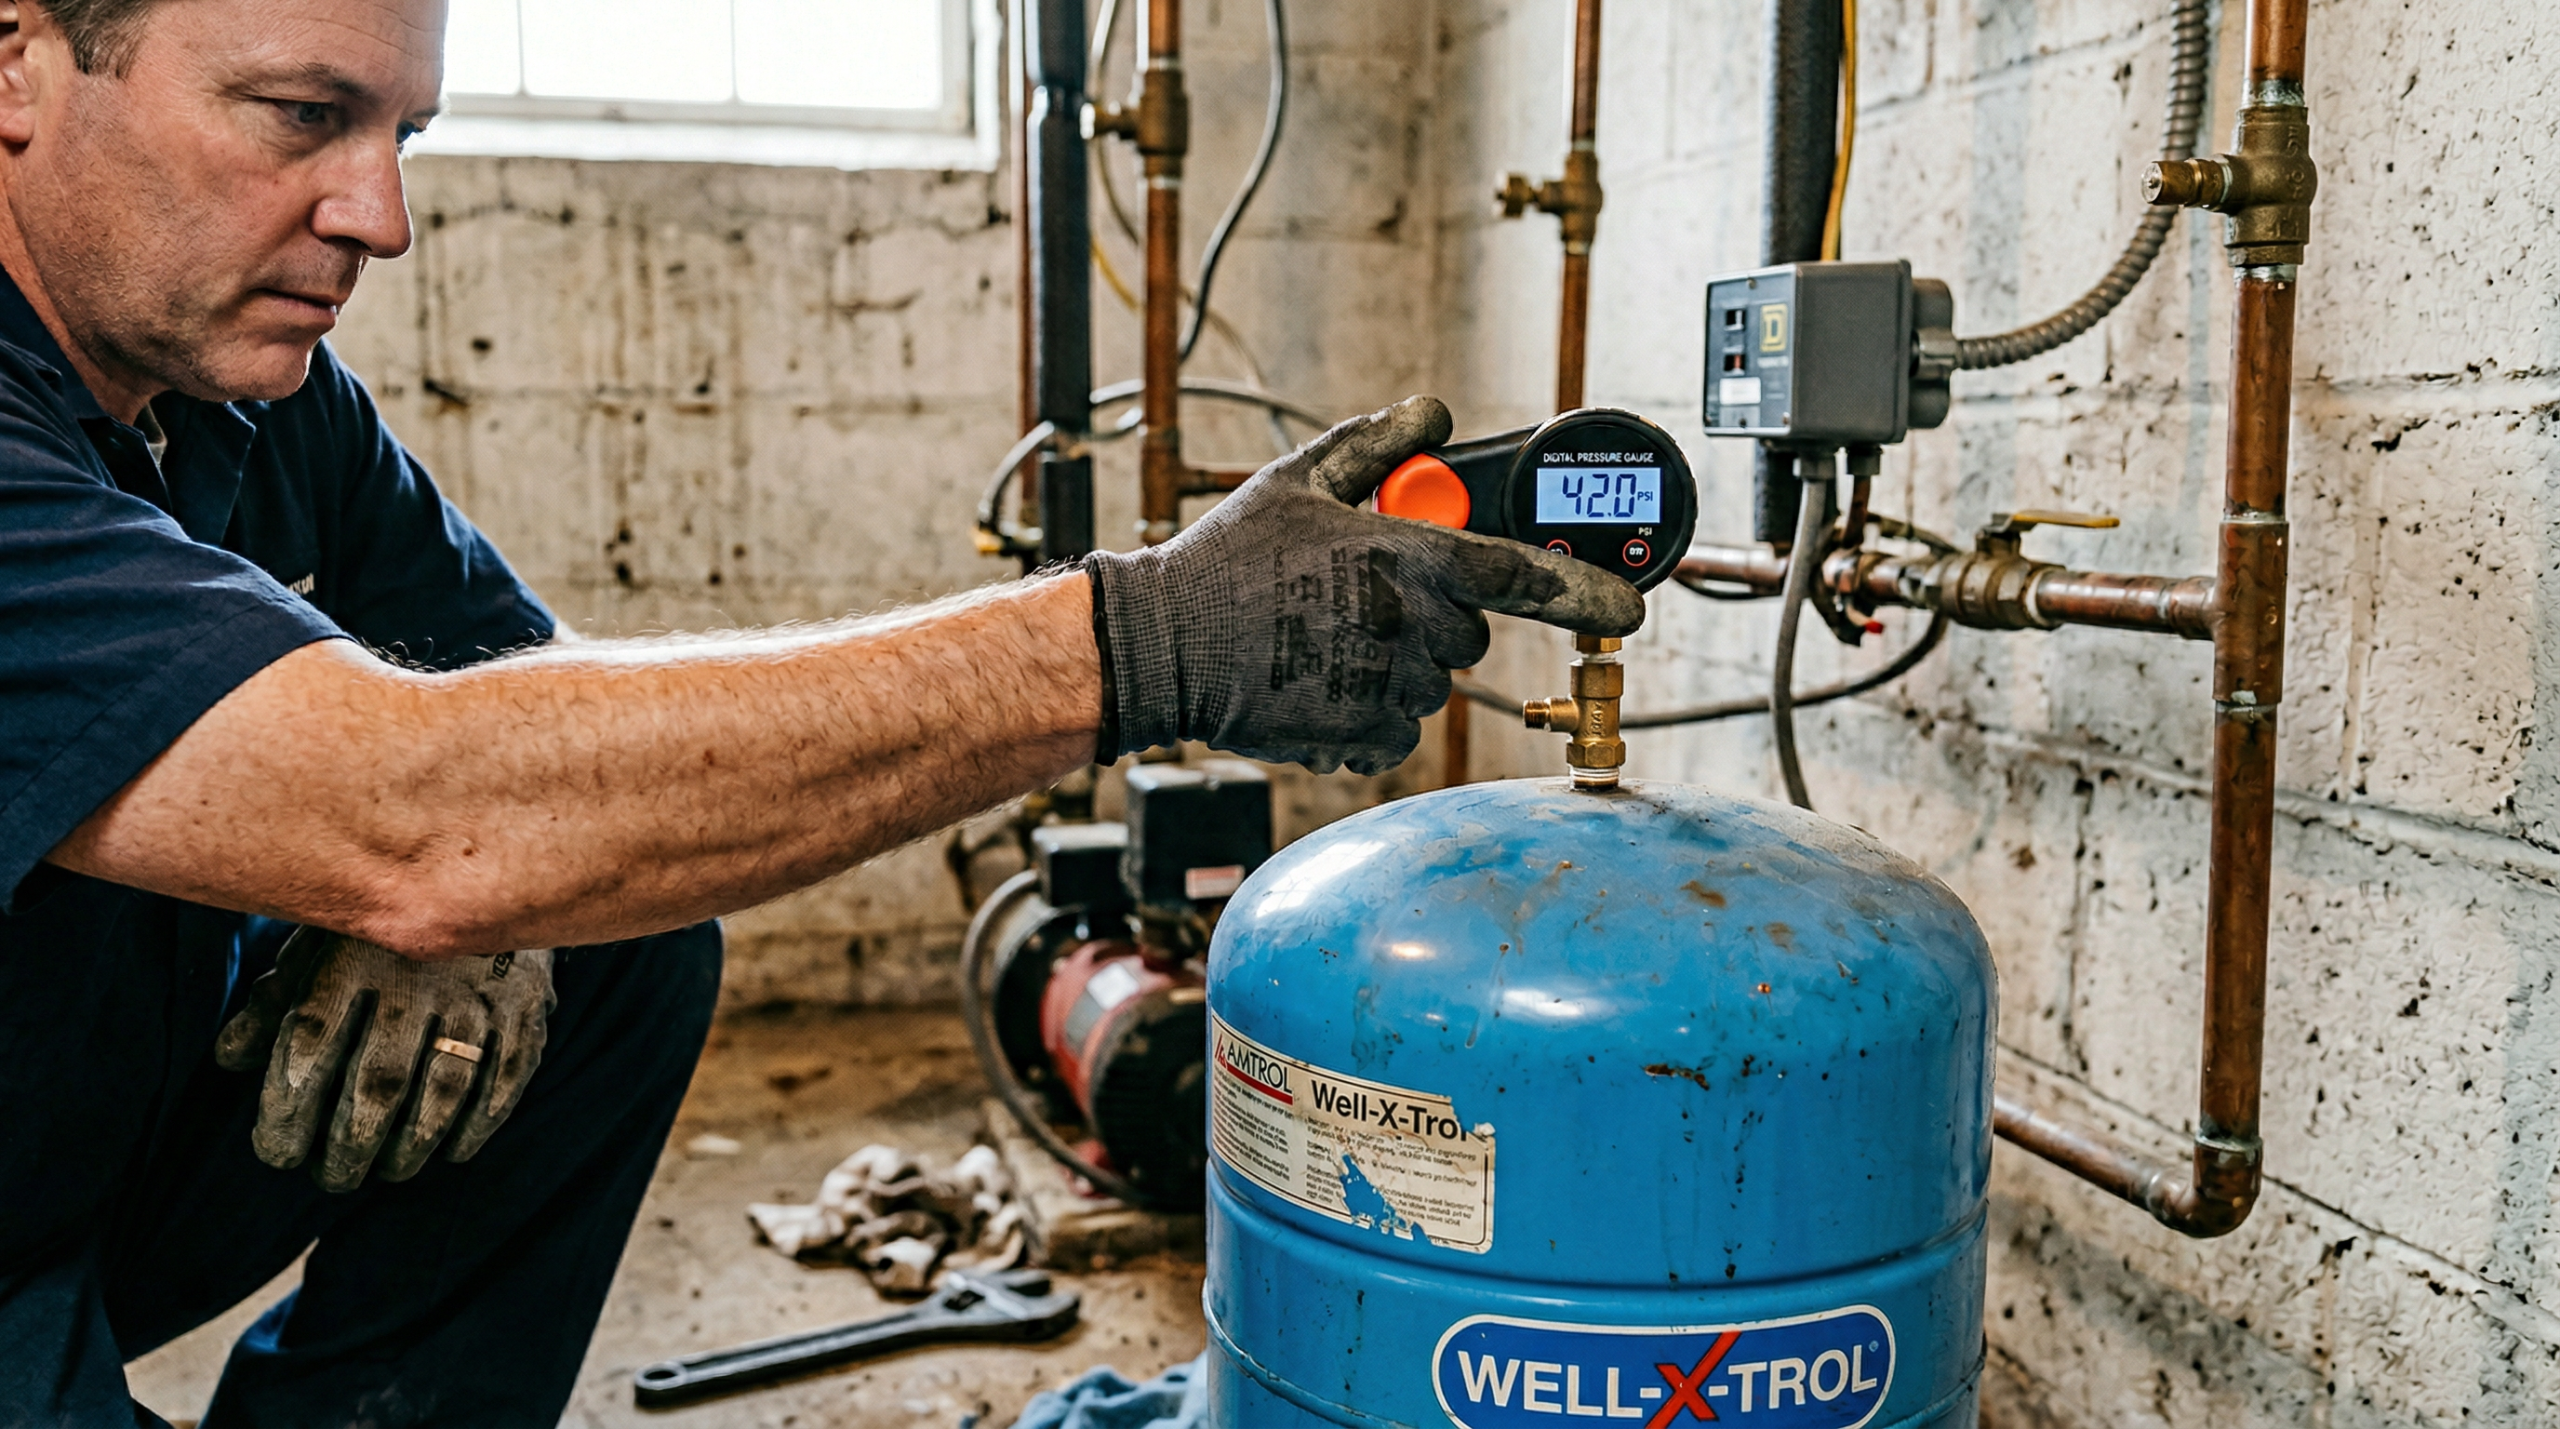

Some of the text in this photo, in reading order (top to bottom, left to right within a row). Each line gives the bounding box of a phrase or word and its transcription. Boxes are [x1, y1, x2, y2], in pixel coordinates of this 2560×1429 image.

[1577, 452, 1622, 463] PRESSURE
[1623, 452, 1654, 463] GAUGE
[1562, 473, 1653, 518] 42.0 PSI
[1638, 527, 1652, 536] PSI
[1227, 1041, 1293, 1094] AMTROL
